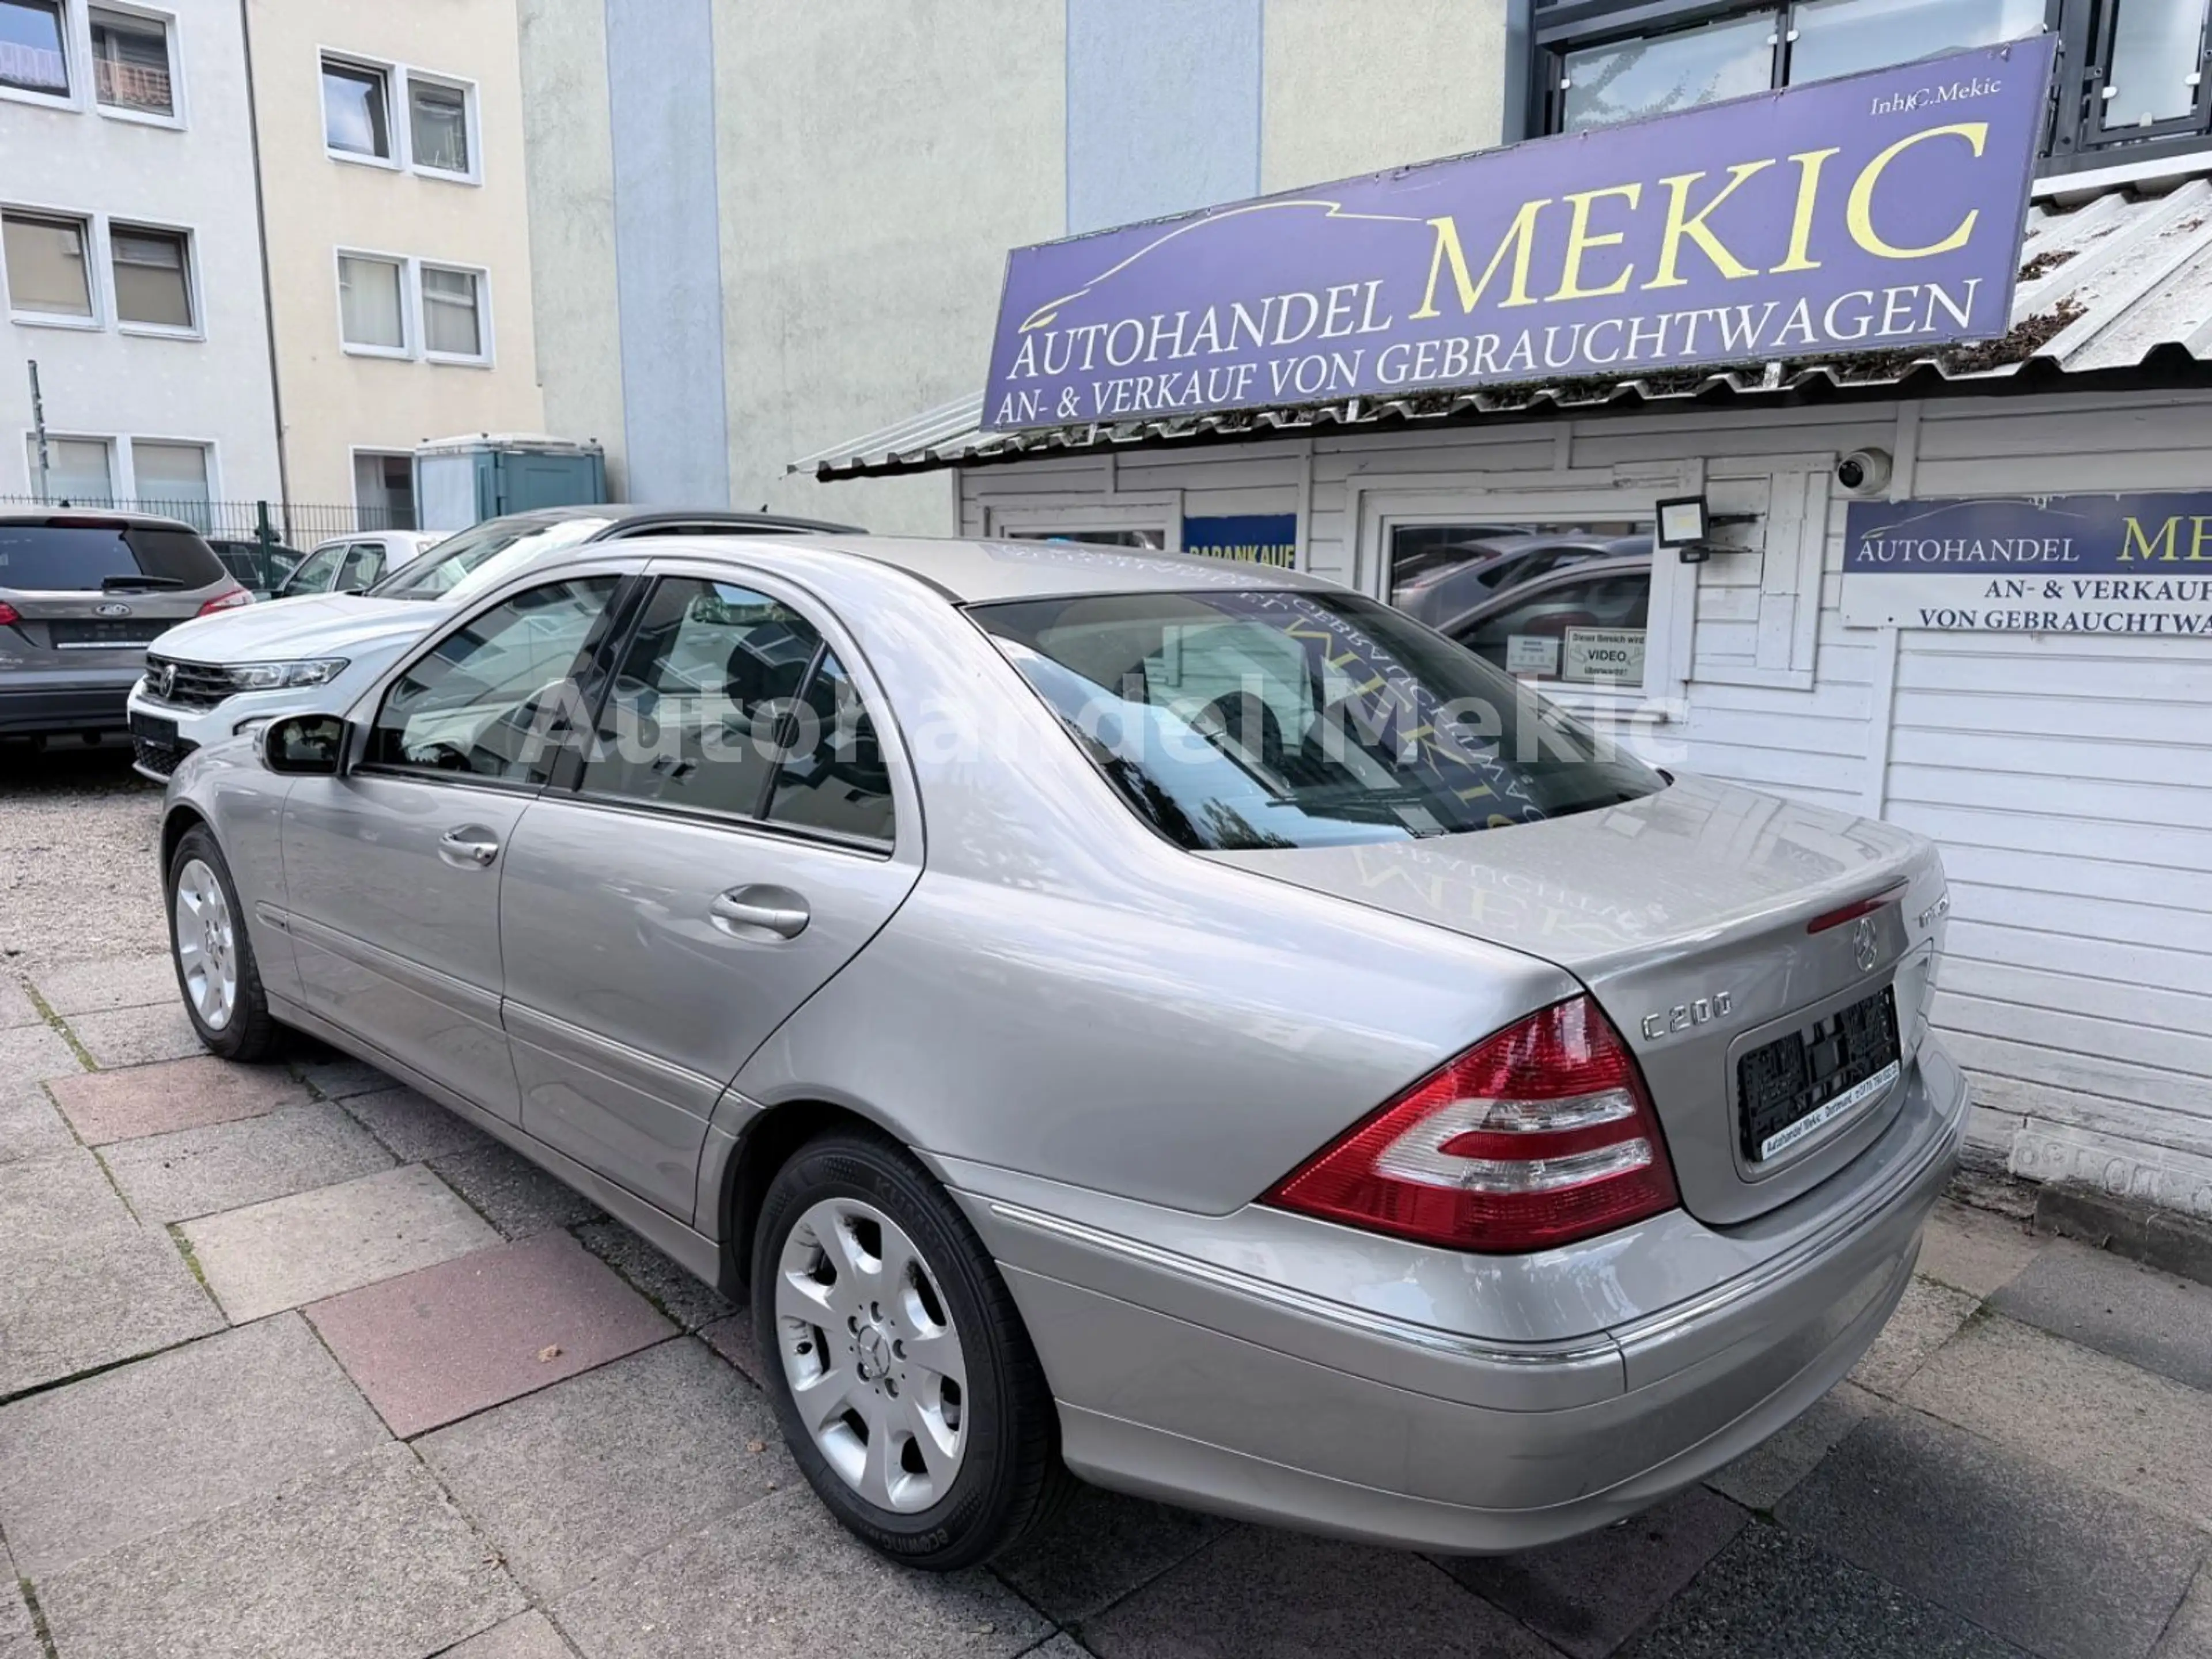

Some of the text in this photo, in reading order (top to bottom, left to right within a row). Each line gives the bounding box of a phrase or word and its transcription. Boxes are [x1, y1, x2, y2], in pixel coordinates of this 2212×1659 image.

[1006, 122, 1990, 380] AUTOHANDEL MEKIC
[995, 278, 1983, 425] AN- & VERKAUF VON GEBRAUCHTWAGEN
[1855, 538, 2080, 563] AUTOHANDEL
[1984, 579, 2035, 599] AN-
[2042, 578, 2063, 599] &
[1919, 608, 1977, 629] VON
[1588, 649, 1627, 662] VIDEO
[1642, 991, 1732, 1041] C 200
